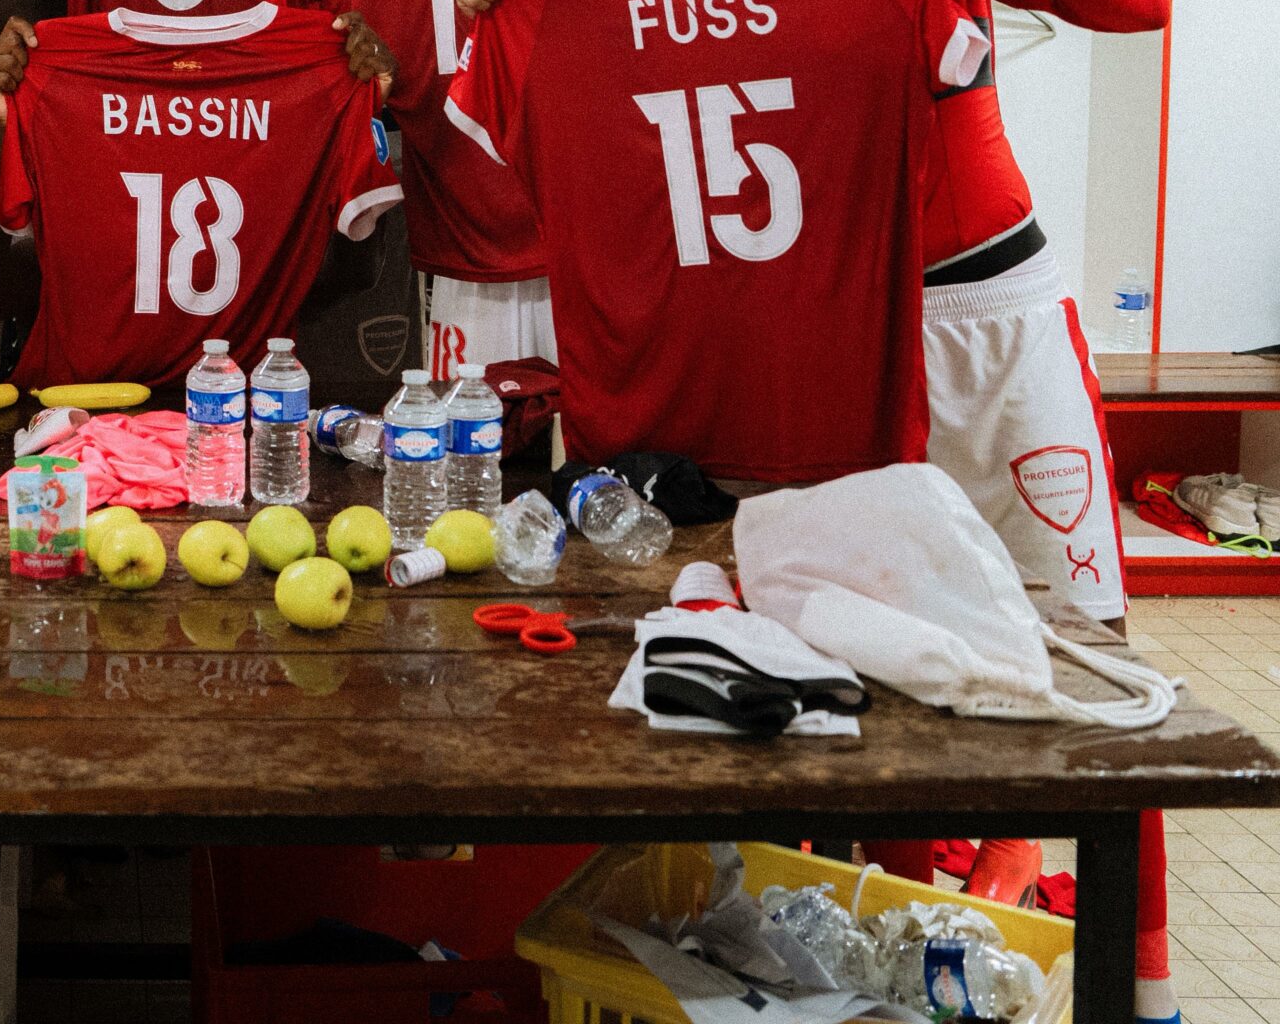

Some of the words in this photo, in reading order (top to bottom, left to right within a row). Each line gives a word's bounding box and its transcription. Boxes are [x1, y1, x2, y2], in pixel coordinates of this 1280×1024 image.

[102, 93, 270, 141] BASSIN
[631, 77, 803, 267] 15
[120, 172, 244, 316] 18
[1023, 465, 1085, 481] PROTECSURE
